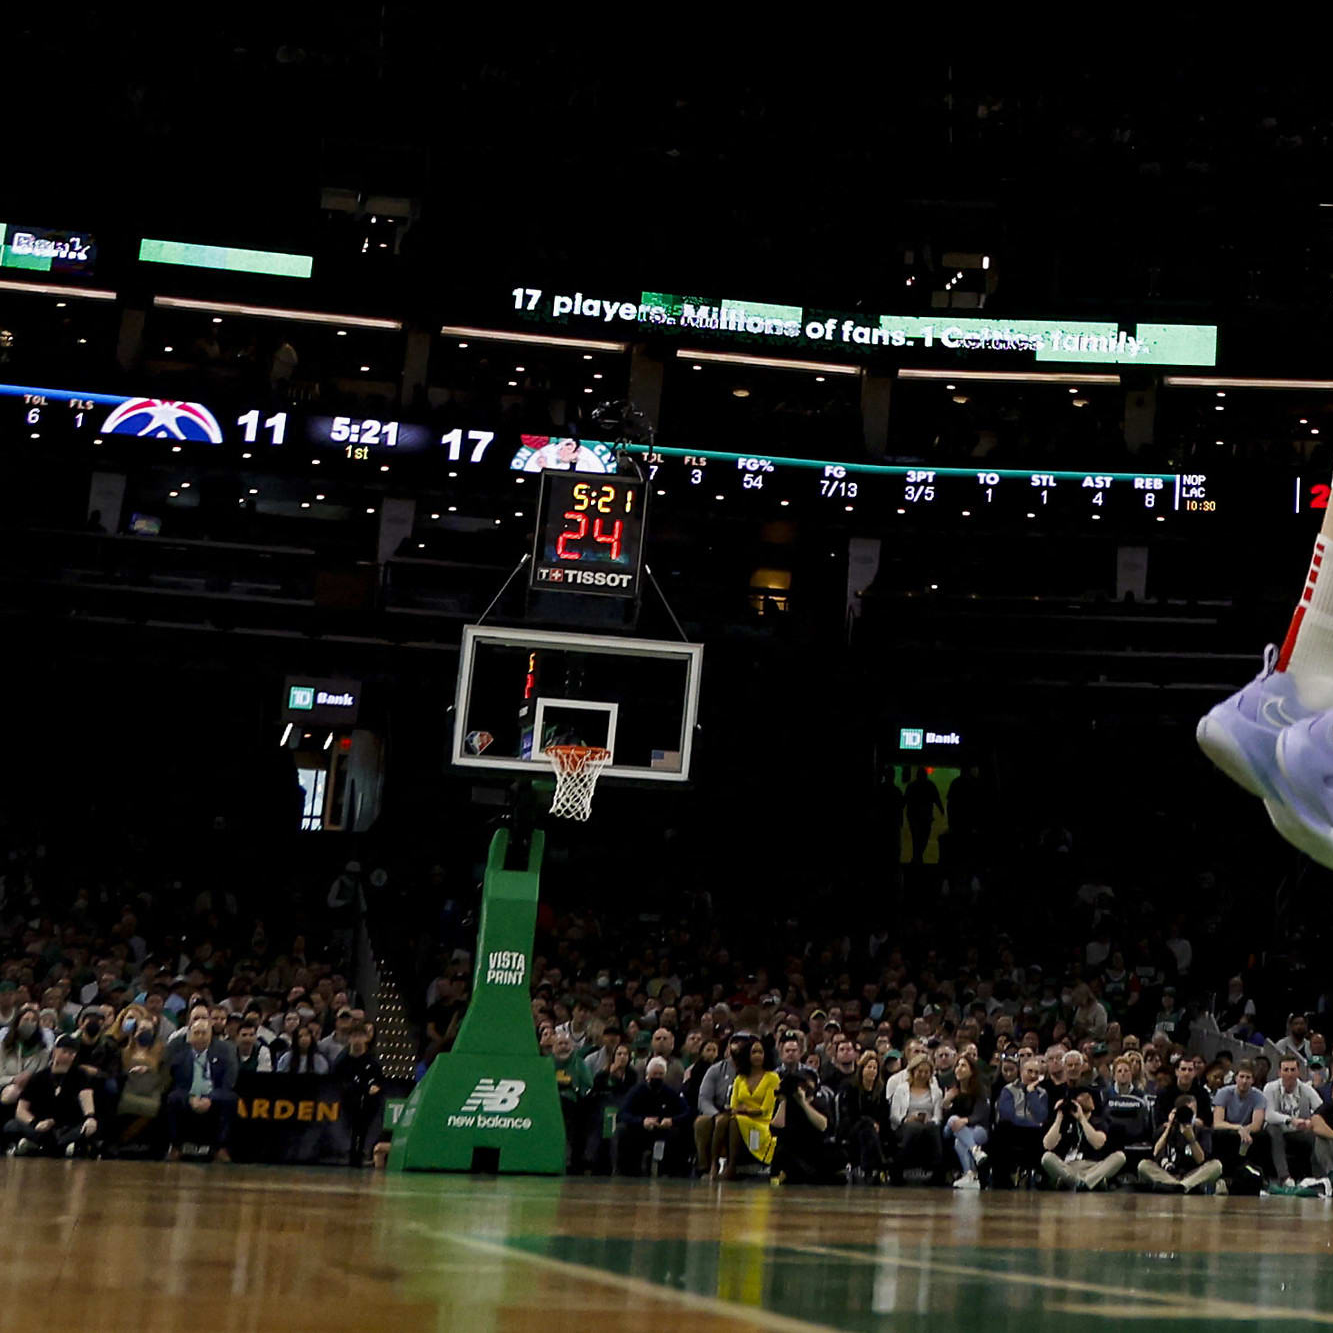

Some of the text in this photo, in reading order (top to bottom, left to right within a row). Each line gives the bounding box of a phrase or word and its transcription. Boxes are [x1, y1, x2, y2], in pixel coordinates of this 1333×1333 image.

[512, 288, 542, 311] 17
[805, 320, 833, 340] of
[841, 320, 915, 346] fans.
[922, 327, 933, 347] 1
[69, 398, 94, 411] FLS
[27, 407, 84, 428] 6 1
[237, 409, 287, 445] 11
[330, 416, 399, 446] 5:21
[441, 428, 495, 463] 17
[345, 445, 369, 461] 1st
[684, 456, 1164, 490] FLS FG% FG 3PT TO STL AST REB
[1182, 474, 1207, 486] NOP
[690, 468, 1156, 508] 3 54 7/13 3/5 1 1 4 8
[1181, 486, 1206, 499] LAC
[573, 483, 633, 513] 5:21
[1185, 500, 1216, 512] 10:30
[556, 511, 623, 560] 24
[564, 570, 632, 588] TISSOT
[291, 688, 353, 707] TD Bank
[902, 731, 960, 747] TD Bank
[489, 951, 525, 971] VISTA
[487, 969, 524, 985] PRINT
[237, 1099, 339, 1122] ARDEN
[447, 1113, 533, 1131] new balance
